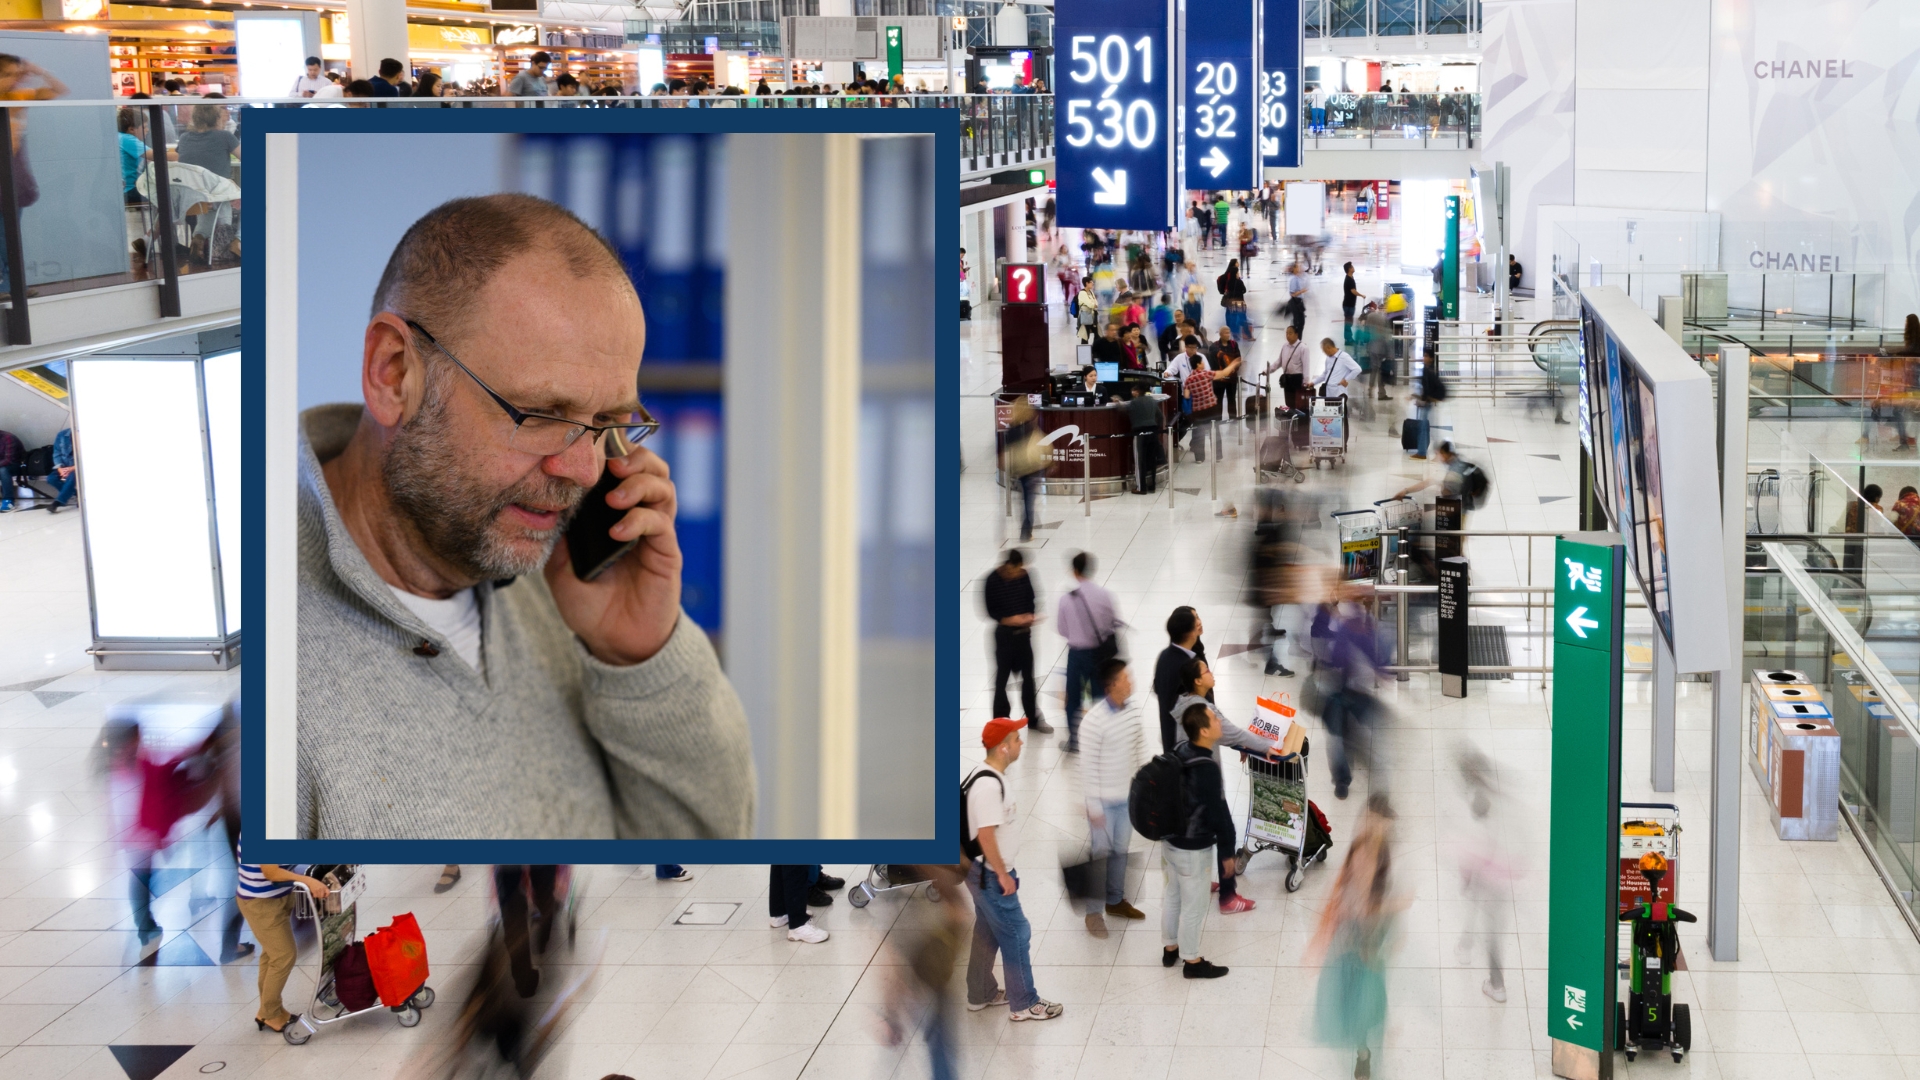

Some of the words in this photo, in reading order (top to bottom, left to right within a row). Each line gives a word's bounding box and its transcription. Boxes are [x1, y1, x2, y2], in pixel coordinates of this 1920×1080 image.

[1069, 34, 1152, 84] 501
[1753, 59, 1854, 80] CHANEL
[1195, 62, 1238, 95] 20
[1066, 98, 1156, 149] 530
[1195, 105, 1236, 137] 32
[1749, 250, 1846, 273] CHANEL
[1648, 1007, 1657, 1022] 5
